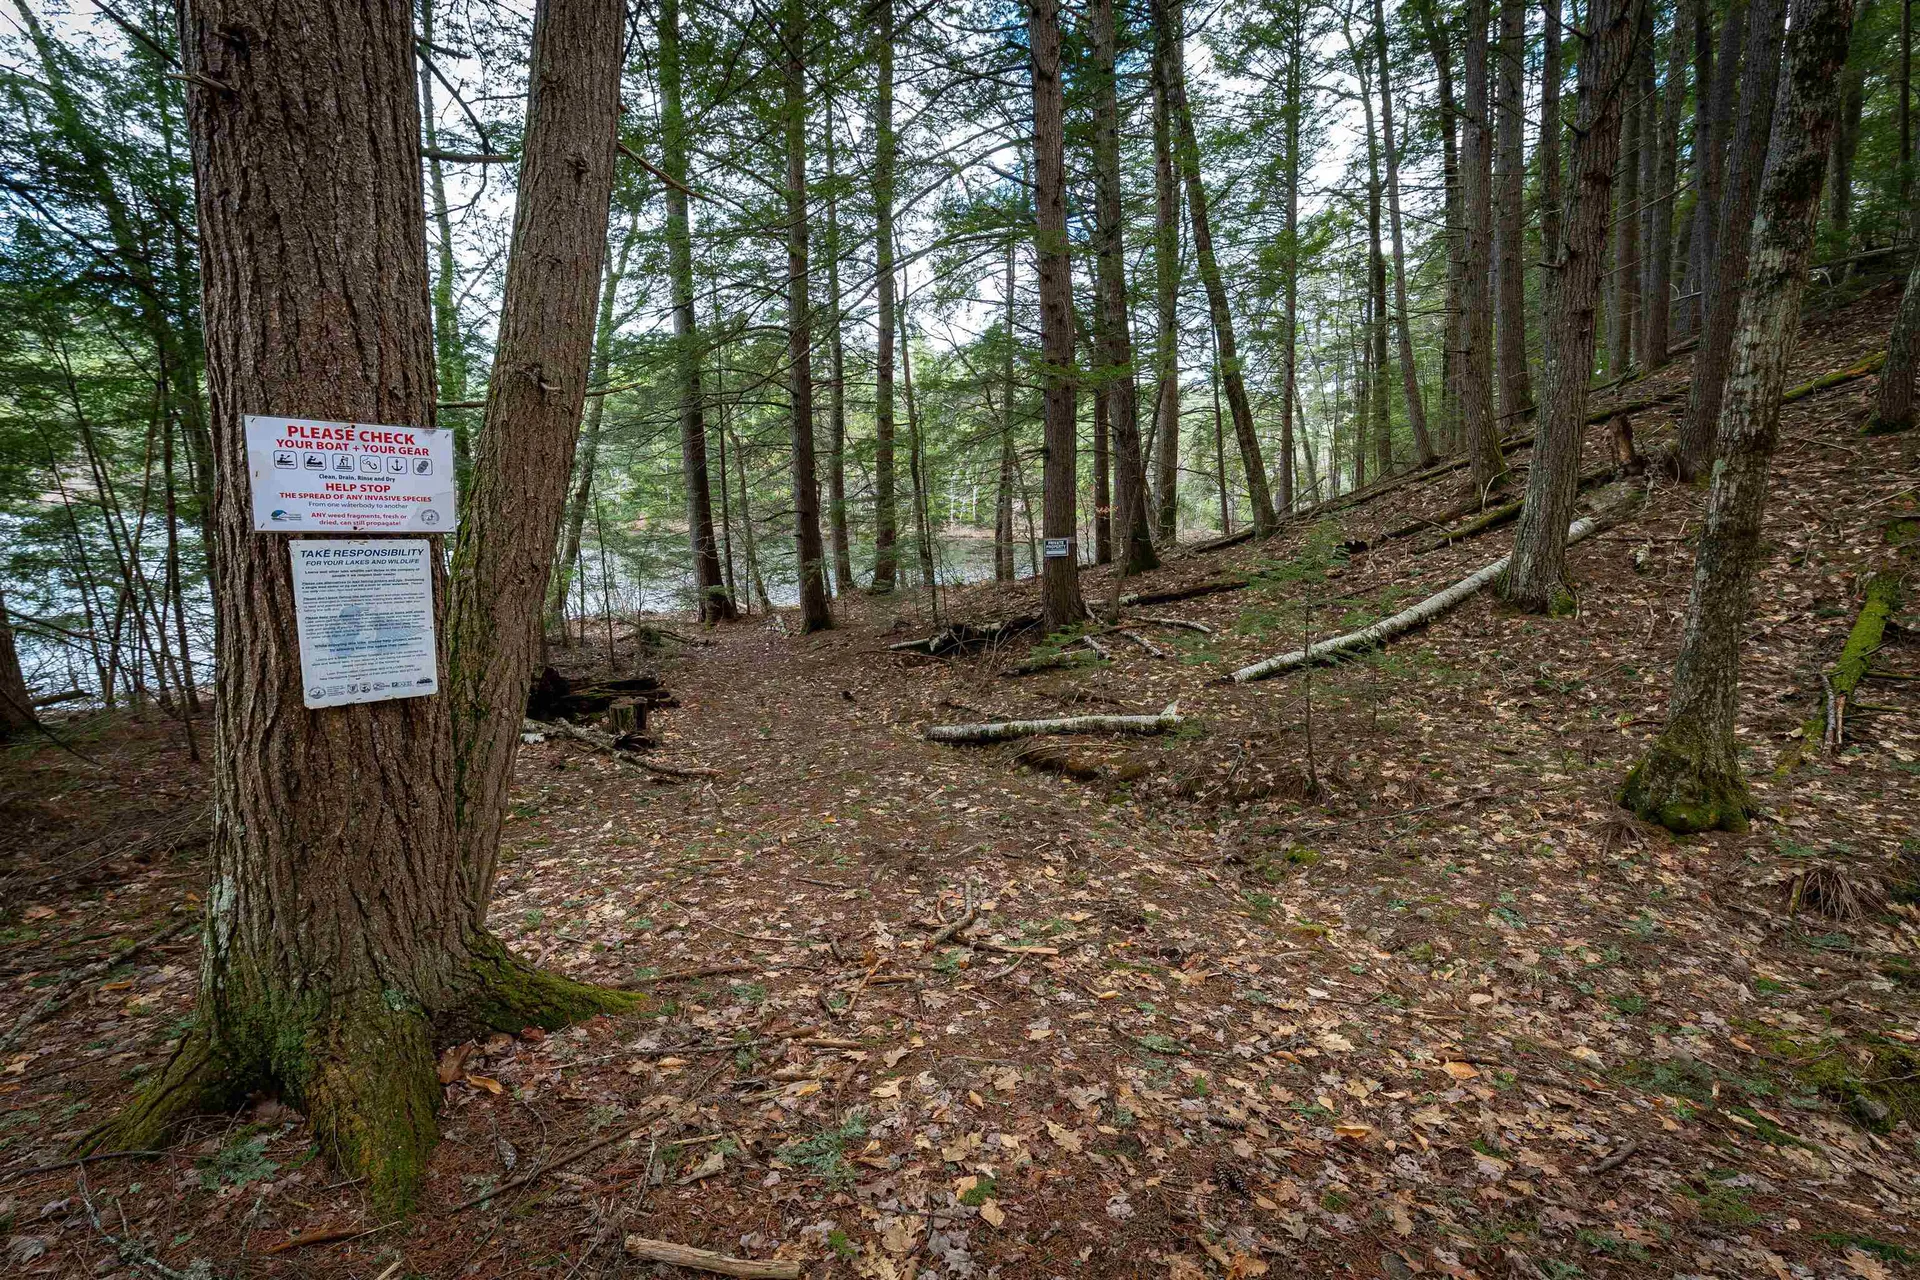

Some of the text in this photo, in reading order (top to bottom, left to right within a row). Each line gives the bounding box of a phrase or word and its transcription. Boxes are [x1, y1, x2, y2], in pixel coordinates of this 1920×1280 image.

[287, 425, 416, 445] PLEASE CHECK
[276, 439, 313, 450] YOUR
[317, 441, 350, 451] BOAT
[362, 444, 396, 454] YOUR
[398, 446, 429, 456] GEAR
[326, 483, 391, 493] HELP STOP
[301, 549, 424, 558] TAKE RESPONSIBILITY
